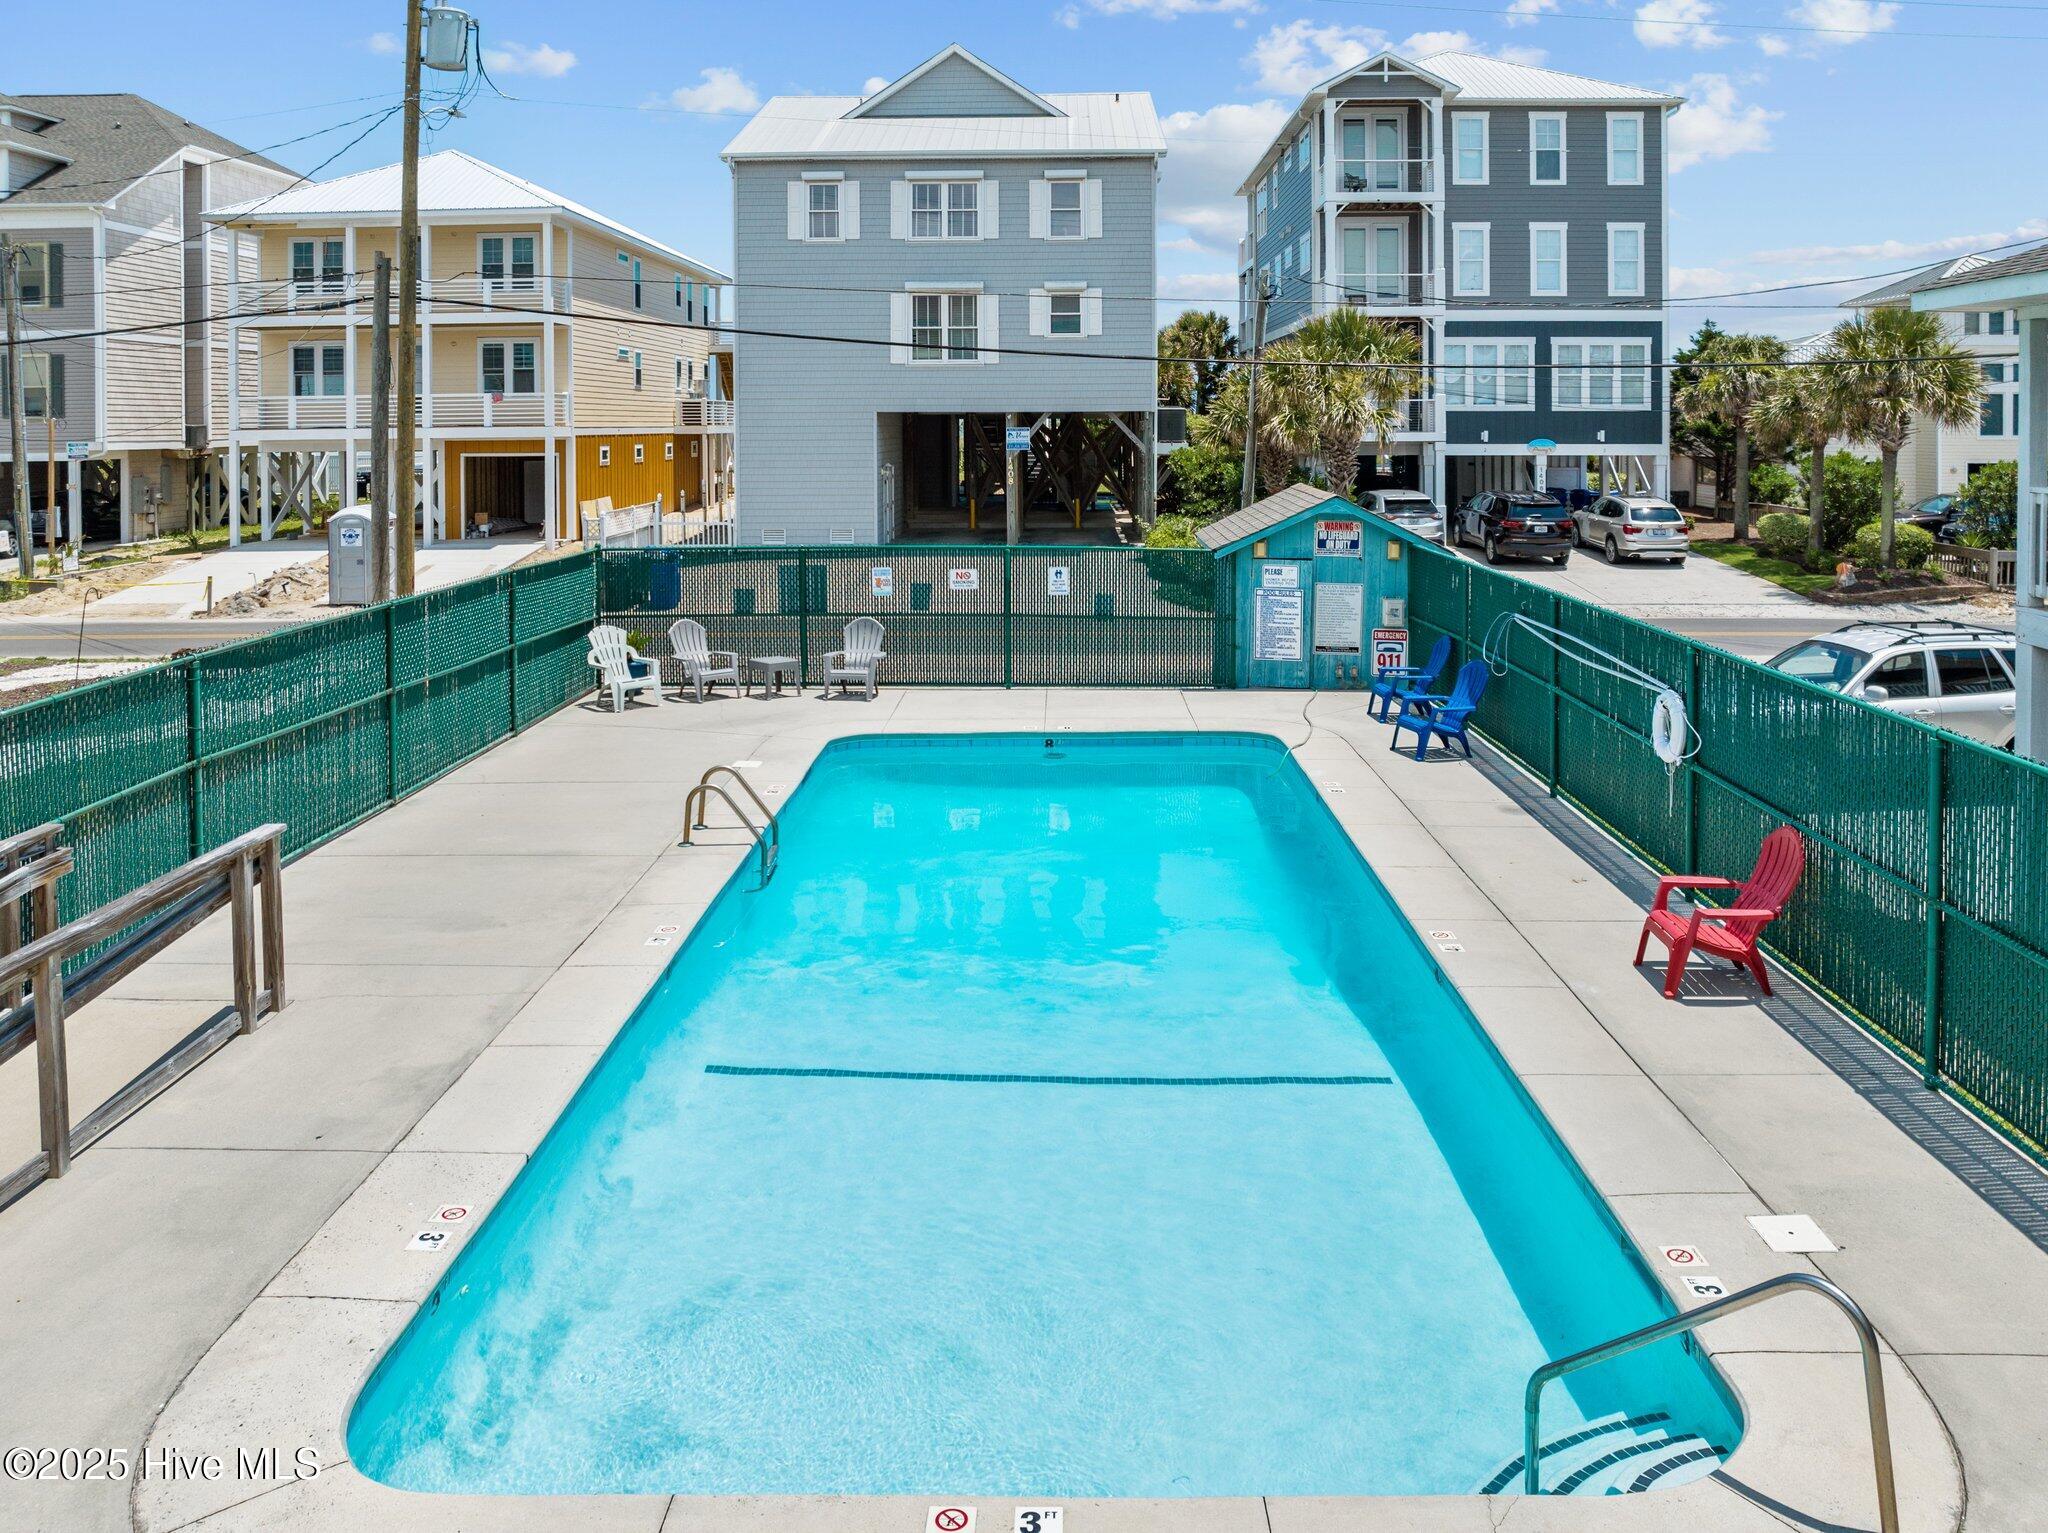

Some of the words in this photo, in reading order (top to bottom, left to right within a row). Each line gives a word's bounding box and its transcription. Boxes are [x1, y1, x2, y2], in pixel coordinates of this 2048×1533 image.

[1324, 522, 1354, 531] WARNING
[1319, 531, 1329, 540] NO
[1329, 531, 1359, 541] LIFEGUARD
[1326, 540, 1335, 549] ON
[1335, 540, 1351, 550] DUTY
[955, 571, 972, 580] NO
[1264, 568, 1283, 576] PLEASE
[1374, 631, 1407, 640] EMERGENCY
[1377, 653, 1401, 673] 911
[1693, 1285, 1723, 1295] 3
[1019, 1511, 1042, 1533] 3
[1044, 1511, 1058, 1519] FT
